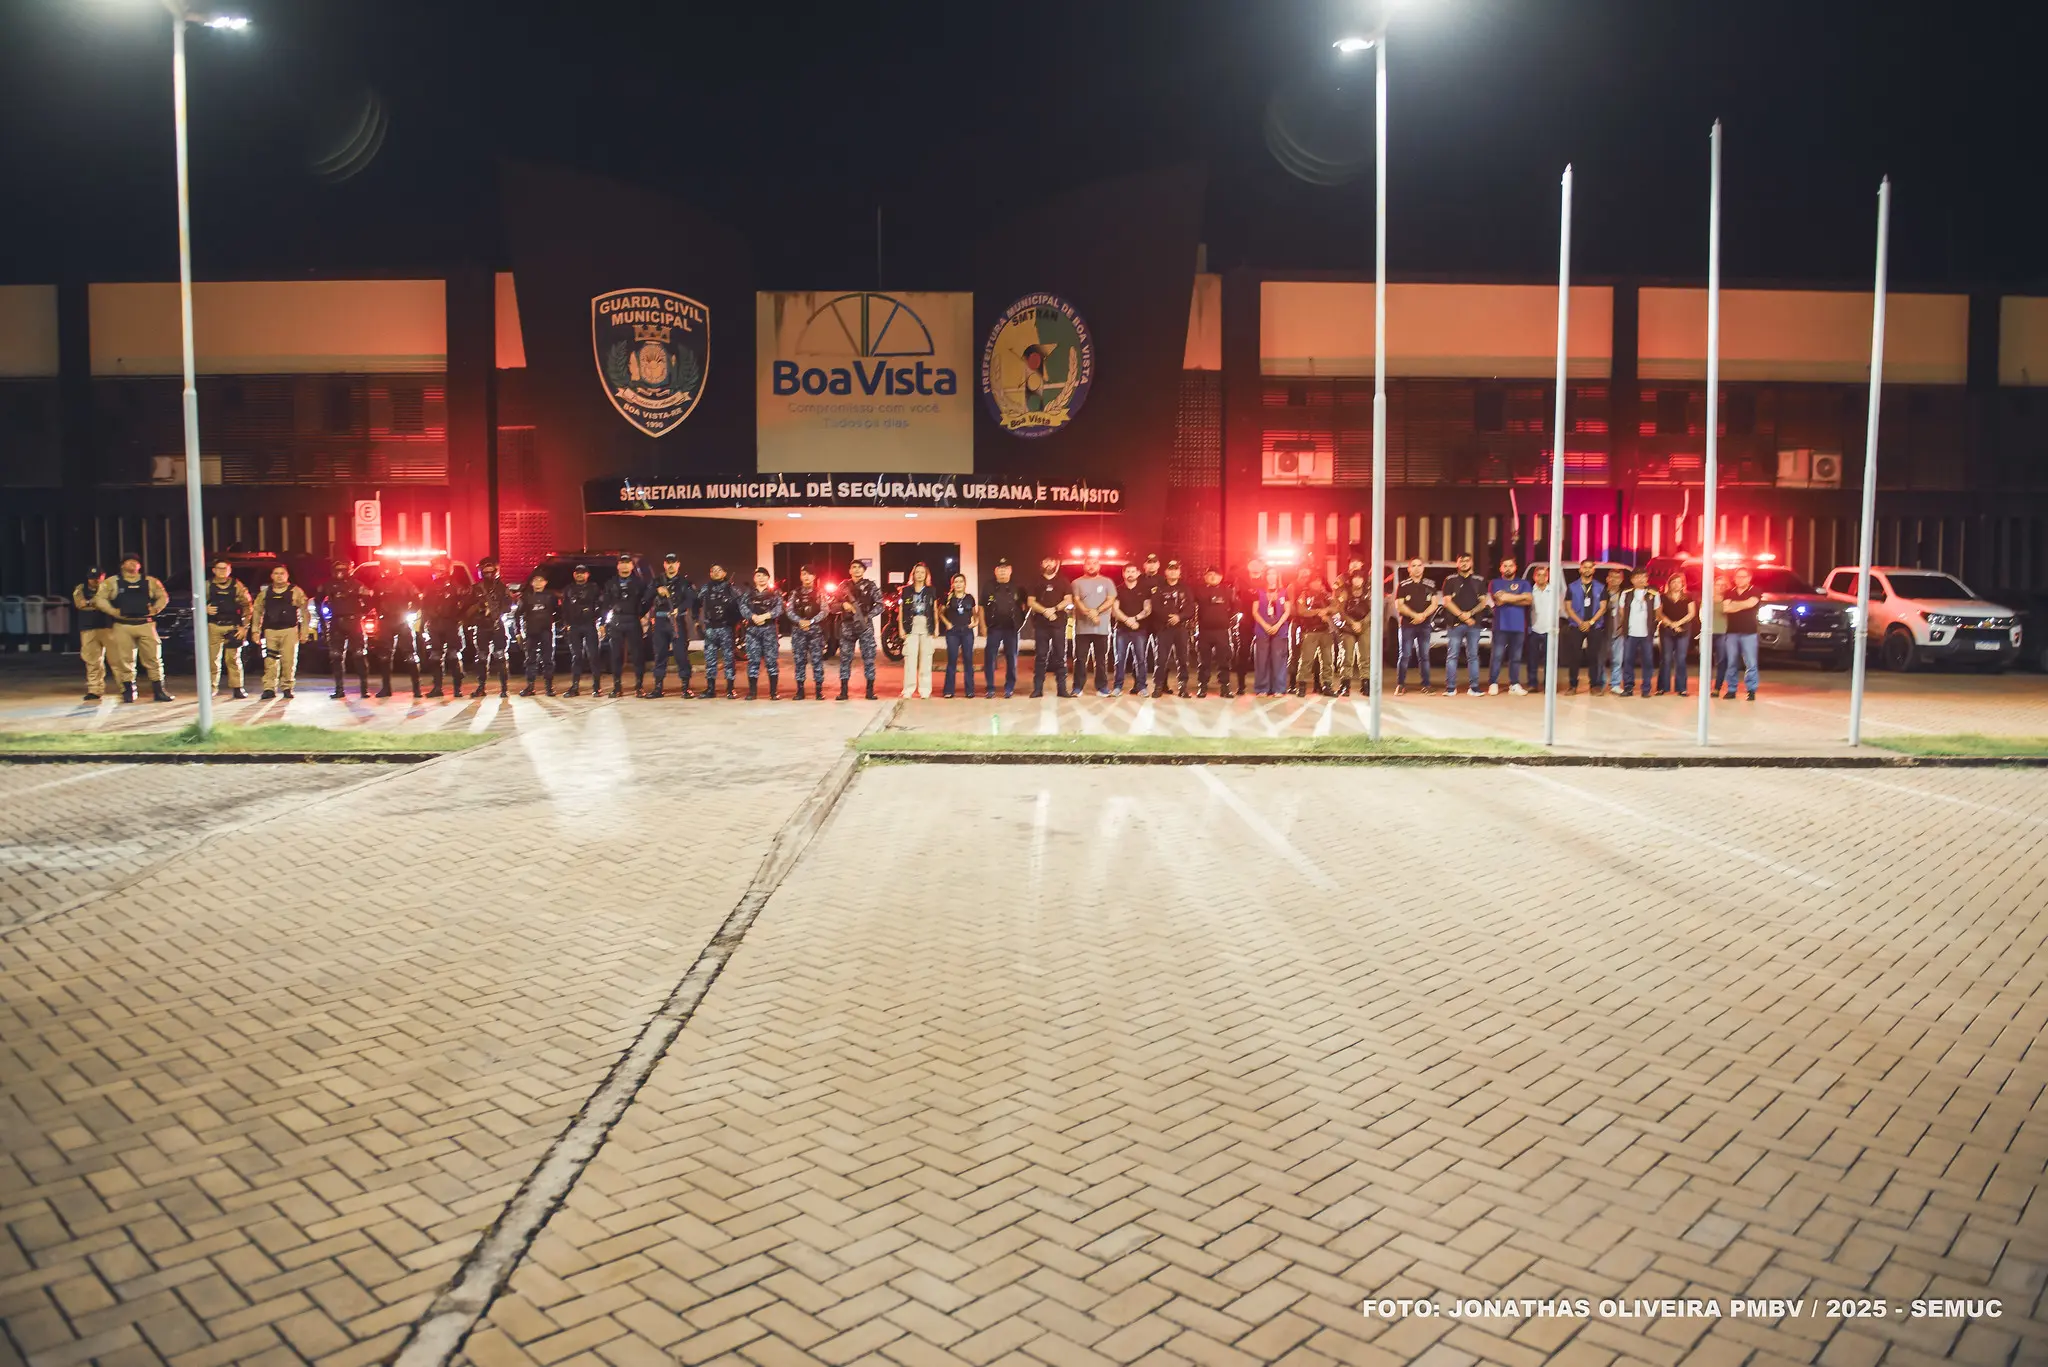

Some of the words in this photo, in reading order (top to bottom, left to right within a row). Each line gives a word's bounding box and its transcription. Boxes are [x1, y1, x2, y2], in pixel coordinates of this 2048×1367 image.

[600, 296, 660, 314] GUARDA
[664, 299, 703, 323] CIVIL
[611, 311, 692, 332] MUNICIPAL
[1006, 295, 1059, 318] MUNICIPAL
[1072, 316, 1087, 343] BOA
[1080, 344, 1092, 385] VISTA
[623, 403, 640, 416] BOA
[788, 403, 874, 415] Compromisso
[878, 404, 905, 413] com
[910, 402, 940, 413] você
[1010, 417, 1026, 428] Boa
[1028, 415, 1051, 426] Vista
[620, 485, 702, 501] SECRETARIA
[707, 482, 801, 499] MUNICIPAL
[807, 482, 832, 498] DE
[838, 482, 957, 501] SEGURANÇA
[963, 484, 1030, 500] URBANA
[1037, 486, 1047, 500] E
[1050, 485, 1120, 504] TRÂNSITO
[364, 506, 372, 518] E
